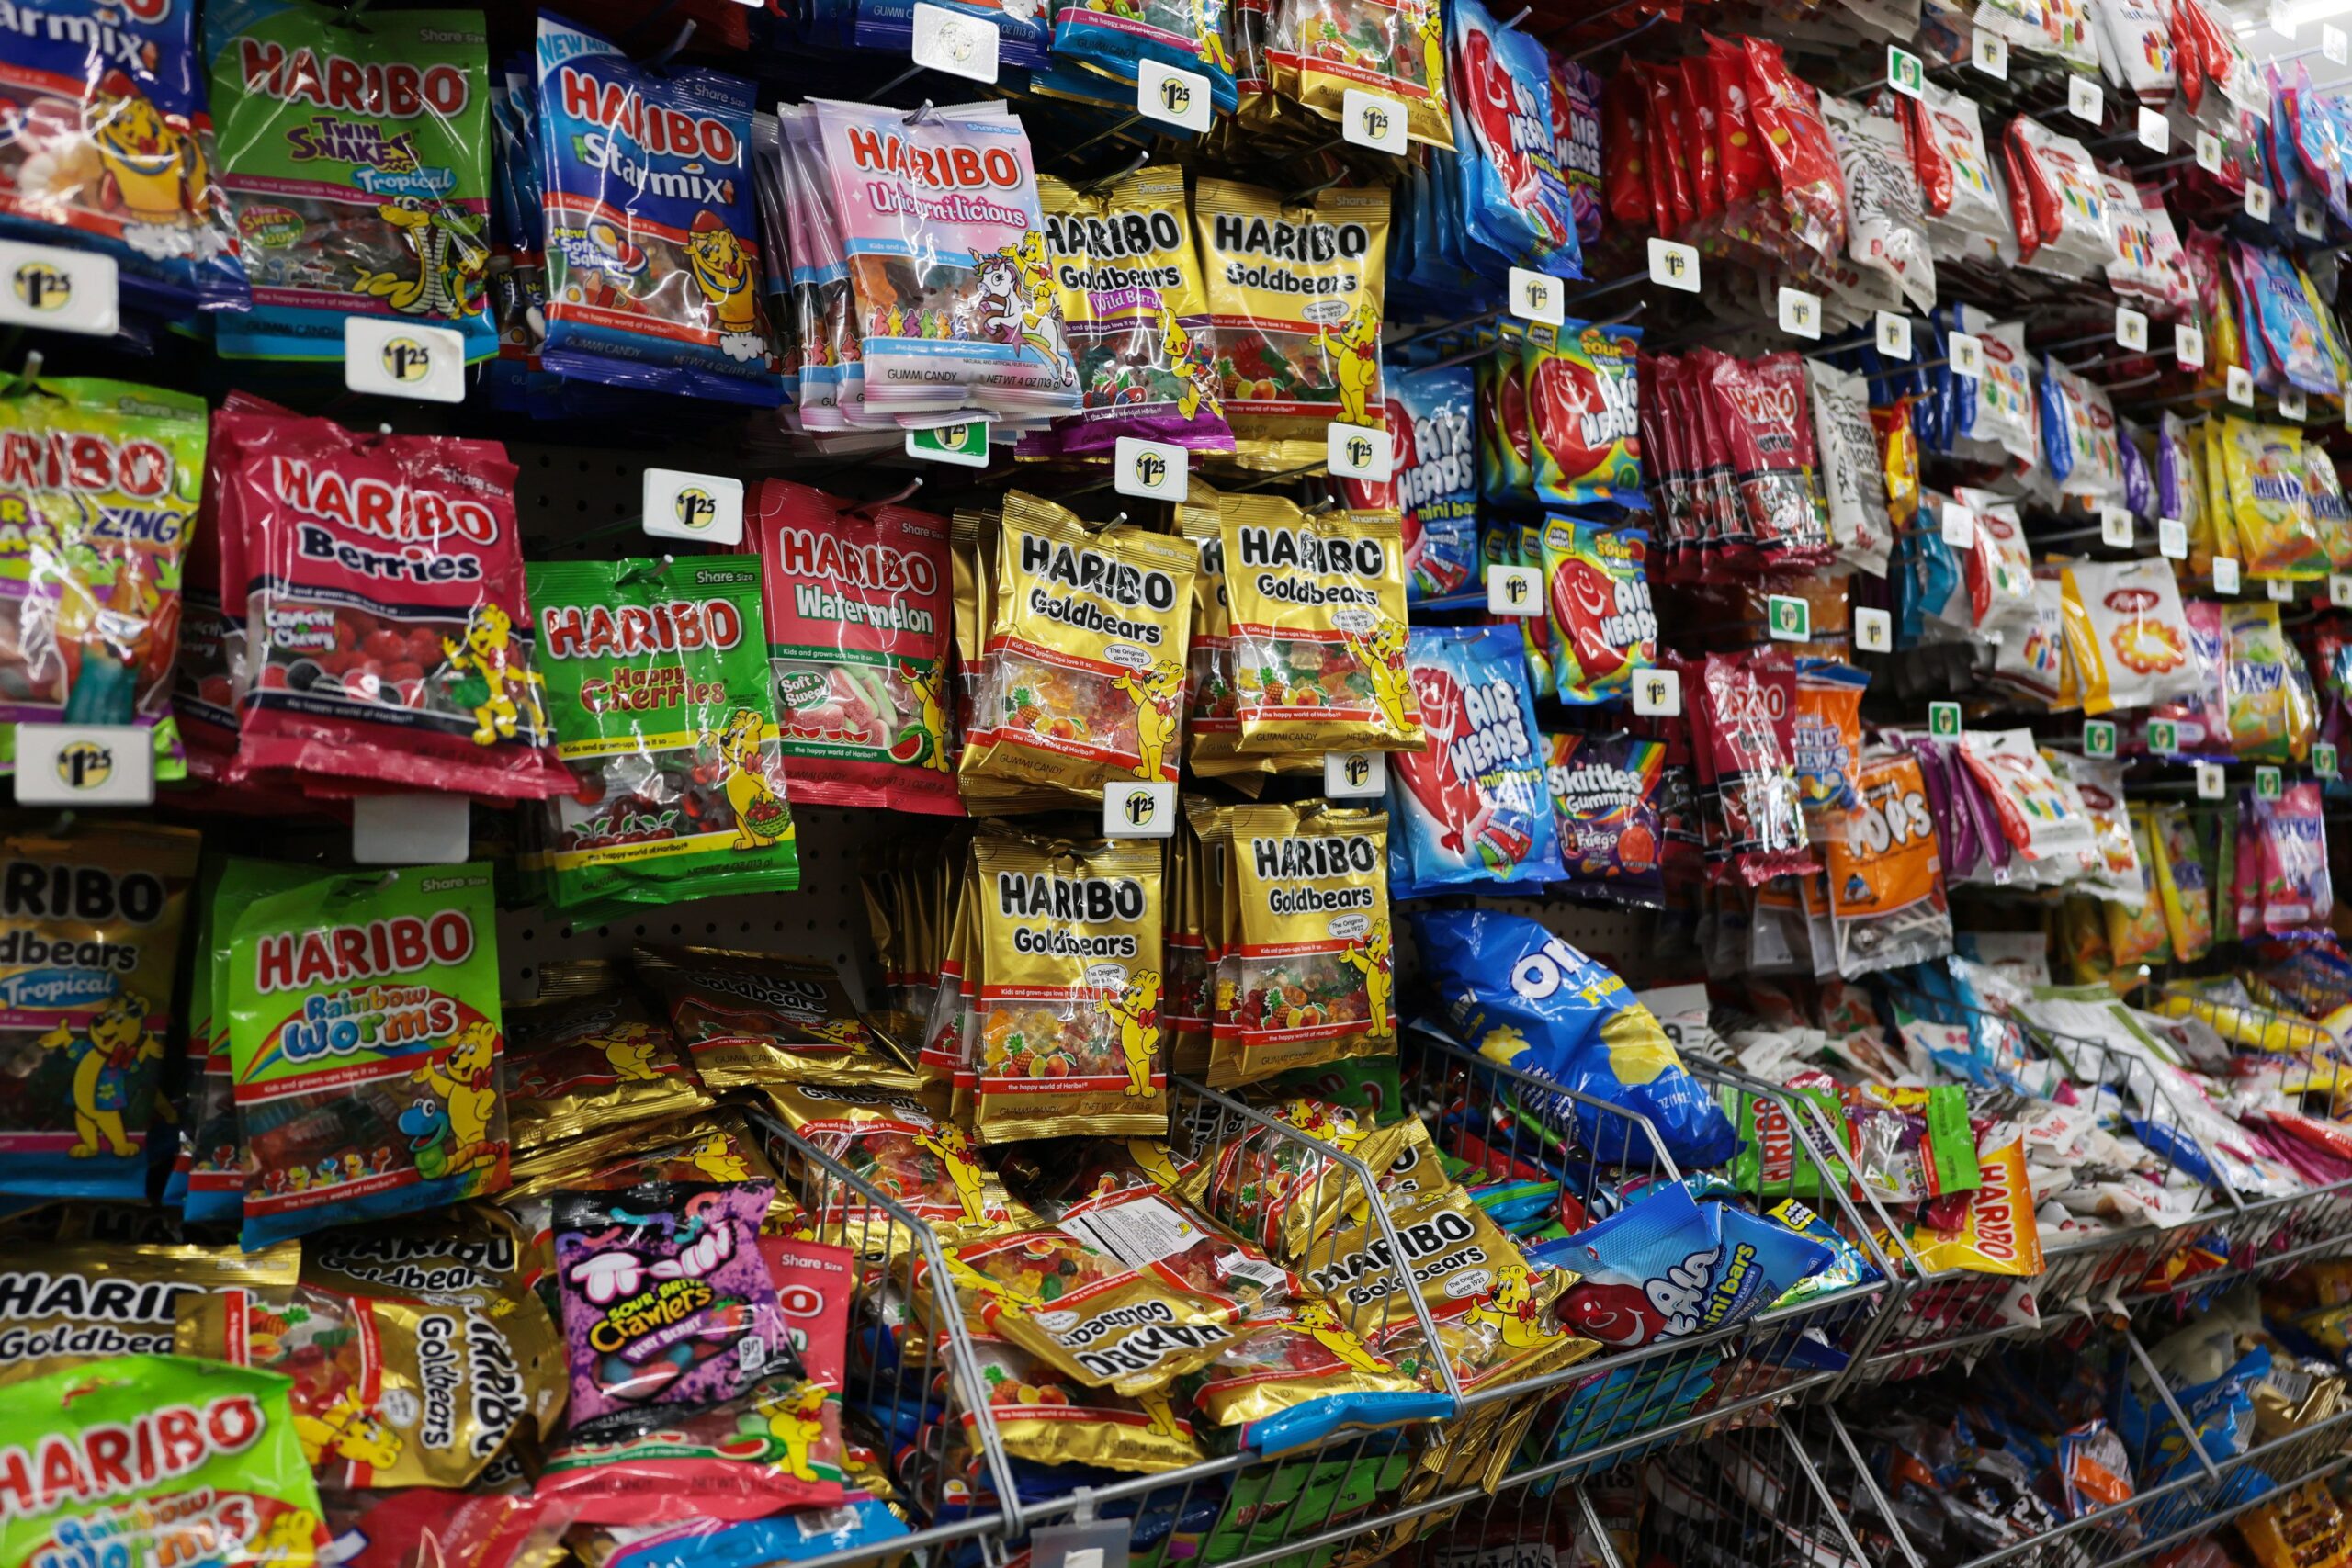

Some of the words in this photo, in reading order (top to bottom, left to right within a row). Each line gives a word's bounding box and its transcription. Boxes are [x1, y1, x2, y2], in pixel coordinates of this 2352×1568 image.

[419, 28, 462, 43] Share
[537, 33, 582, 68] NEW
[241, 37, 468, 118] HARIBO
[693, 84, 729, 104] Share
[1570, 110, 1600, 147] AIR
[583, 132, 726, 204] Starmix
[845, 124, 1021, 191] HARIBO
[1555, 137, 1602, 178] HEADS
[356, 168, 453, 196] Tropical
[1336, 195, 1366, 207] Share
[554, 227, 587, 243] New
[1046, 212, 1181, 261] HARIBO
[1214, 213, 1370, 263] HARIBO
[1060, 263, 1181, 293] Goldbears
[1226, 263, 1357, 294] Goldbears
[1095, 291, 1125, 311] Wild
[888, 368, 922, 381] GUMMI
[923, 370, 957, 384] CANDY
[1415, 413, 1472, 459] AIR
[0, 428, 175, 501] RIBO
[1396, 451, 1473, 507] HEADS
[273, 455, 498, 546] HARIBO
[1418, 505, 1448, 521] mini
[902, 522, 930, 538] Share
[297, 521, 483, 585] Berries
[779, 525, 937, 595] HARIBO
[1239, 524, 1385, 580] HARIBO
[696, 570, 734, 584] Share
[735, 572, 754, 582] Size
[1022, 533, 1177, 610] HARIBO
[1257, 573, 1378, 608] Goldbears
[1615, 580, 1652, 615] AIR
[796, 584, 933, 636] Watermelon
[1029, 587, 1163, 645] Goldbears
[543, 597, 742, 660] HARIBO
[1247, 626, 1260, 635] Kids
[1600, 613, 1657, 648] HEADS
[783, 648, 797, 657] Kids
[798, 649, 811, 658] and
[813, 650, 846, 660] grown-ups
[847, 653, 860, 661] love
[1108, 647, 1121, 656] The
[1122, 648, 1145, 659] Original
[1113, 654, 1128, 662] since
[1130, 654, 1145, 663] 1922
[614, 663, 686, 689] Happy
[782, 676, 812, 693] Soft
[813, 674, 821, 685] &
[581, 678, 727, 715] Cherries
[785, 685, 827, 707] Sweet
[1464, 681, 1520, 733] AIR
[563, 744, 580, 754] Kids
[581, 742, 597, 753] and
[807, 748, 825, 757] happy
[827, 749, 845, 757] world
[1256, 732, 1287, 742] GUMMI
[1288, 732, 1317, 742] CANDY
[1450, 719, 1530, 780] HEADS
[1000, 753, 1034, 770] GUMMI
[1035, 761, 1065, 776] CANDY
[1548, 761, 1644, 796] Skittles
[1566, 791, 1638, 815] Gummies
[1576, 829, 1618, 850] Fuego
[1252, 835, 1376, 880] HARIBO
[3, 860, 167, 926] RIBO
[422, 875, 464, 893] Share
[467, 875, 489, 886] Size
[998, 871, 1145, 925] HARIBO
[1269, 886, 1374, 915] Goldbears
[1332, 921, 1342, 930] The
[1343, 917, 1363, 929] Original
[1351, 924, 1363, 933] 1922
[256, 908, 474, 996] HARIBO
[1014, 926, 1137, 958] Goldbears
[2, 974, 114, 1006] Tropical
[305, 986, 430, 1021] Rainbow
[1001, 988, 1014, 997] Kids
[1018, 1084, 1035, 1093] happy
[1035, 1082, 1055, 1091] world
[1969, 1162, 2018, 1264] HARIBO
[781, 1253, 821, 1270] Share
[823, 1261, 844, 1273] Size
[1307, 1209, 1476, 1292] HARIBO
[1719, 1242, 1757, 1292] bars
[1449, 1280, 1460, 1291] The
[1461, 1272, 1483, 1285] Original
[1456, 1284, 1471, 1295] since
[1472, 1278, 1487, 1289] 1922
[590, 1286, 712, 1353] Crawlers
[608, 1293, 657, 1321] SOUR
[417, 1314, 454, 1450] Goldbears
[0, 1393, 265, 1520] HARIBO
